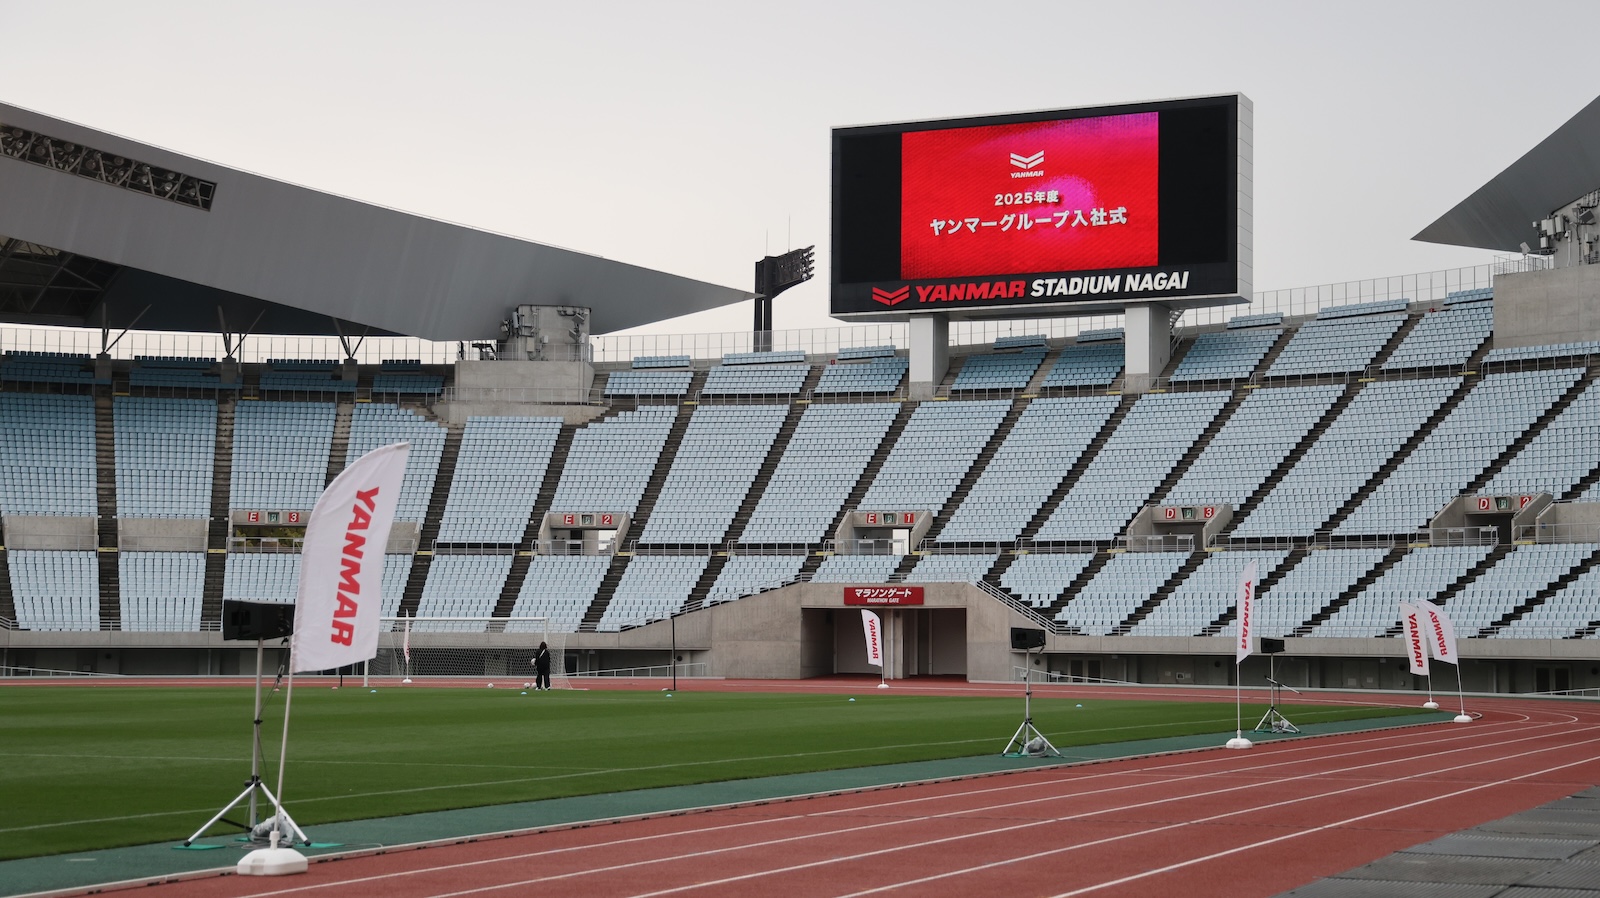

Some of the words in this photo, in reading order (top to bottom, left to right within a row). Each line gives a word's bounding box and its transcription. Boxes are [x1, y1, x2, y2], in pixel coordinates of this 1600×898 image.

[1010, 170, 1044, 179] YANMAR
[994, 189, 1060, 206] 2025年度
[929, 206, 1128, 236] ヤンマーグループ入社式
[915, 280, 1026, 303] YANMAR
[1030, 273, 1122, 297] STADIUM
[1124, 271, 1190, 292] NAGAI
[1479, 498, 1489, 509] D
[249, 512, 257, 522] E
[290, 512, 298, 522] 3
[565, 515, 573, 524] E
[603, 515, 611, 524] 2
[868, 513, 875, 523] E
[1166, 508, 1174, 518] D
[1205, 507, 1213, 517] 3
[330, 486, 380, 647] YANMAR
[855, 588, 912, 598] マラソンゲート
[1241, 580, 1252, 650] YANMAR
[868, 618, 879, 660] YANMAR
[1408, 612, 1424, 668] YANMAR
